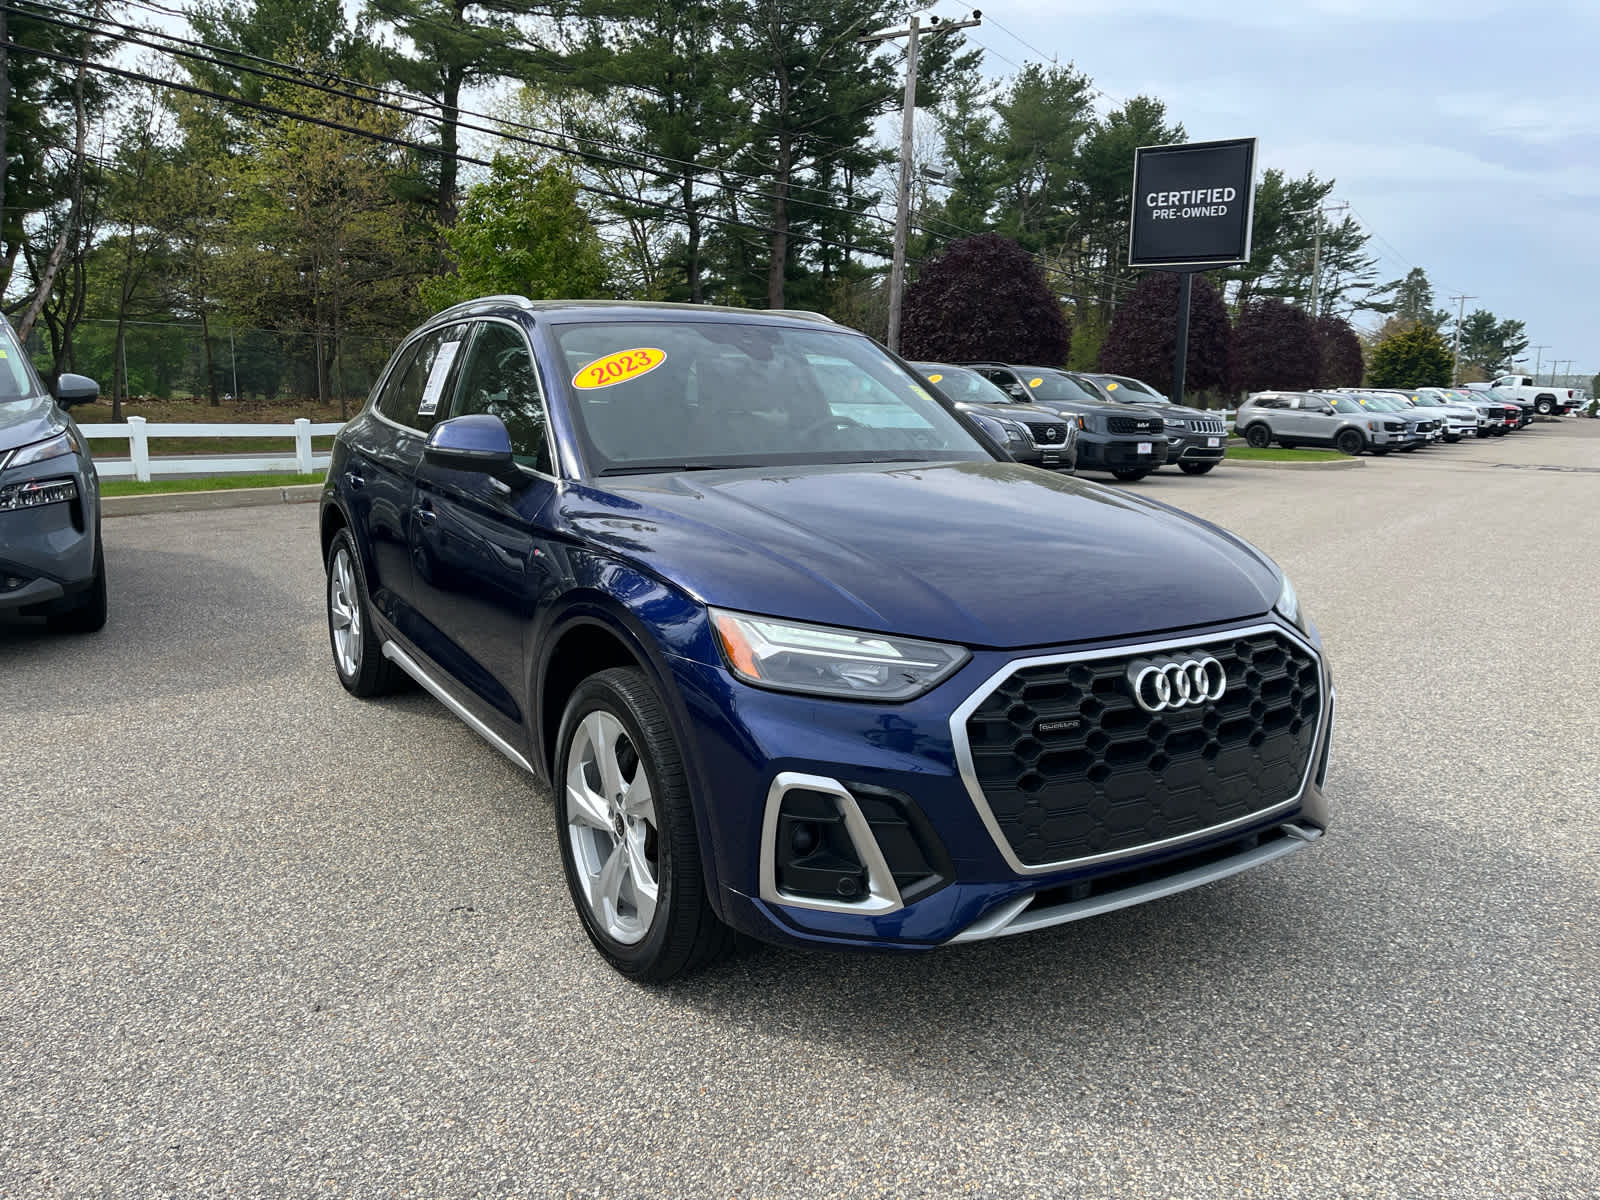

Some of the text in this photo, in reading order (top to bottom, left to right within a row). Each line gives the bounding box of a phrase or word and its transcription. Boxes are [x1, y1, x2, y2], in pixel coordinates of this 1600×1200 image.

[1146, 187, 1236, 207] CERTIFIED
[1152, 205, 1228, 220] PRE-OWNED
[590, 351, 652, 385] 2023
